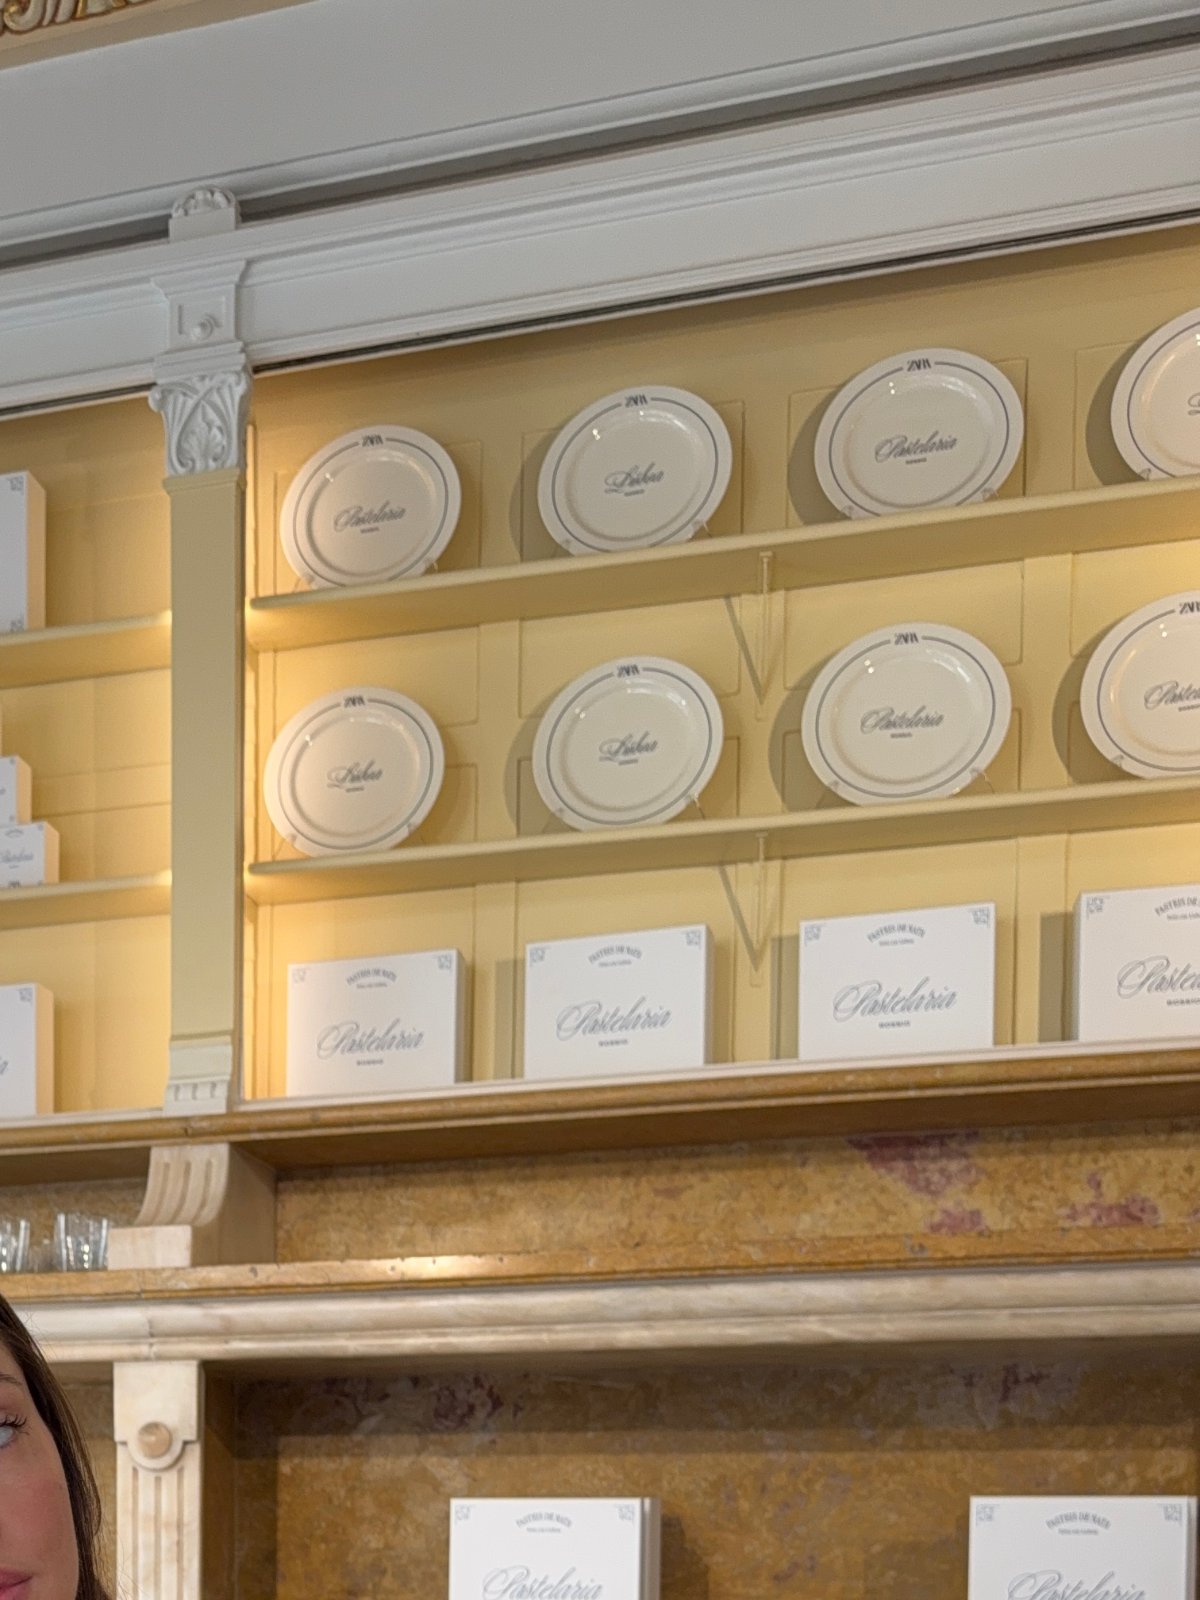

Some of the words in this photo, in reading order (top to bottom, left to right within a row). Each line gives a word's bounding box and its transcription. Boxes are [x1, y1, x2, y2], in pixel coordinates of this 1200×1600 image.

[875, 430, 958, 462] Pastelaria
[556, 996, 672, 1041] Pastelaria
[833, 976, 958, 1022] Pastelaria
[317, 1018, 424, 1060] Pastelaria
